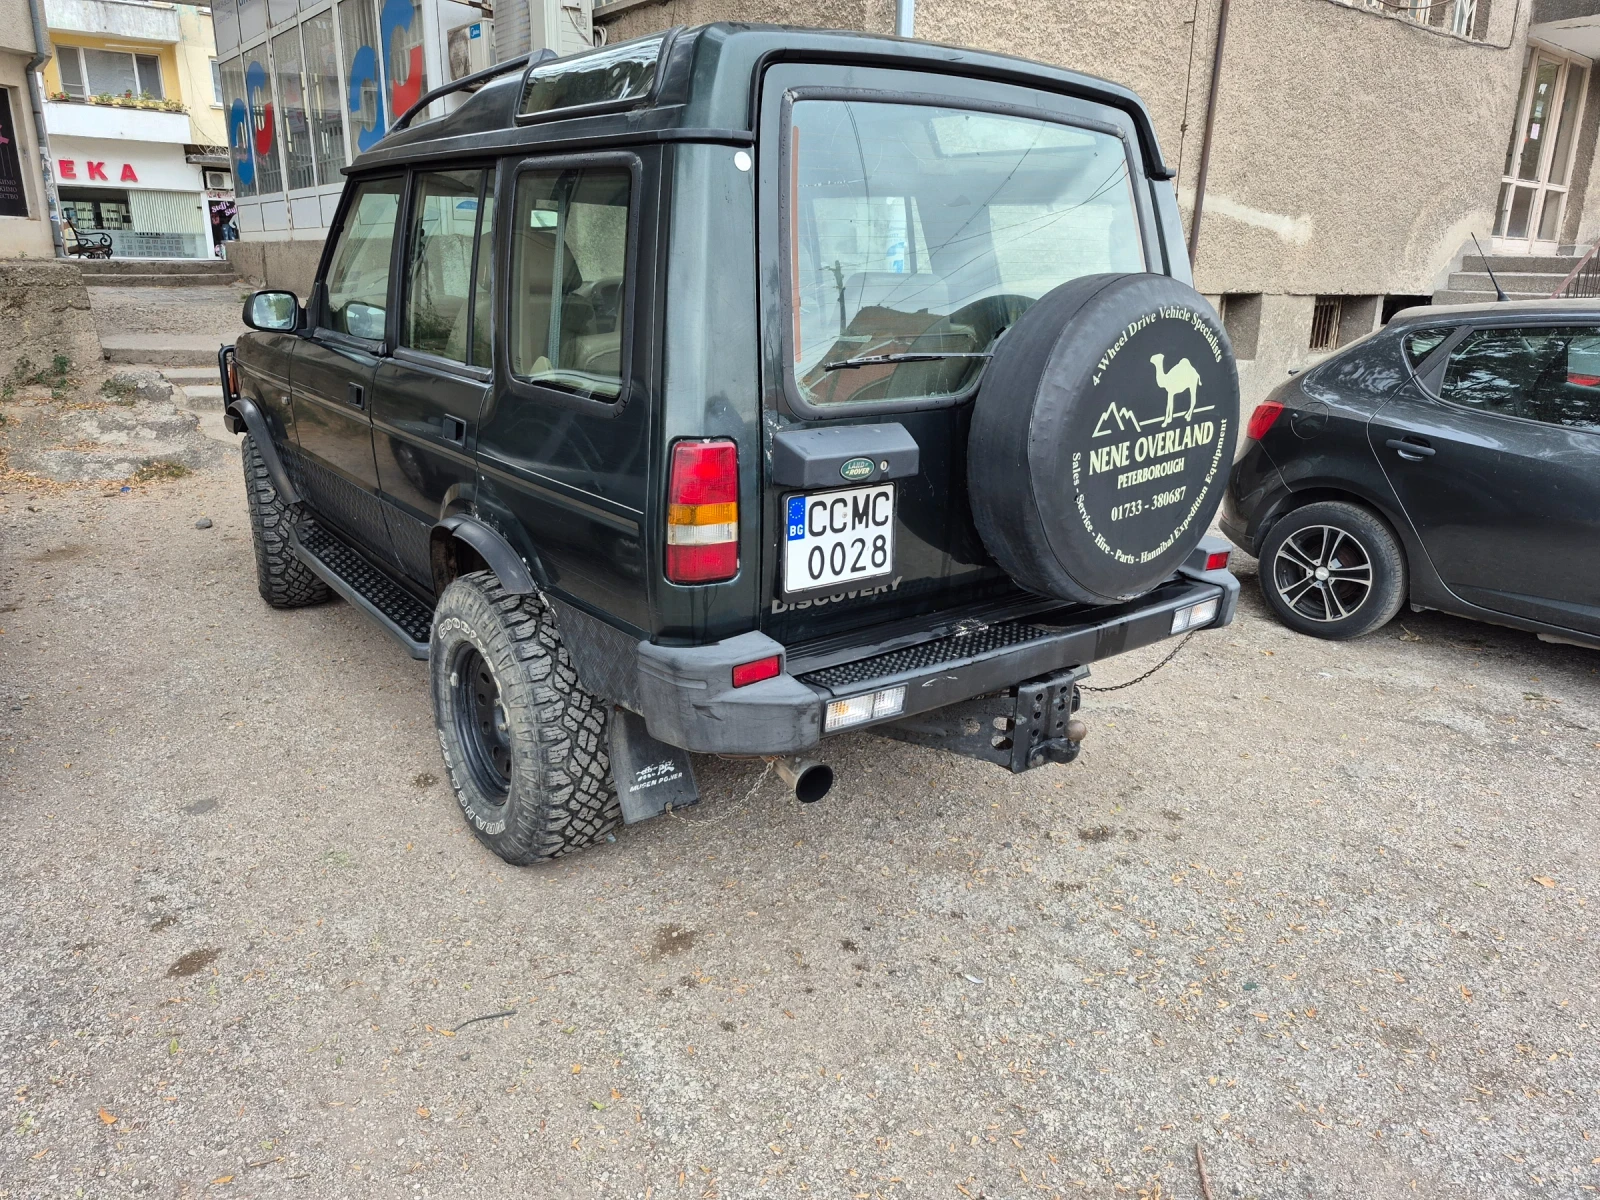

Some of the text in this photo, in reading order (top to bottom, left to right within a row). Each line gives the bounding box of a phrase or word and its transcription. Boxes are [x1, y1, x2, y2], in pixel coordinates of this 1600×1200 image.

[1092, 305, 1223, 386] 4-Wheel Drive Vehicle Specialists
[848, 461, 865, 470] LAND
[1089, 421, 1214, 476] NENE OVERLAND
[1204, 418, 1228, 485] Equipment
[848, 467, 870, 476] ROVER
[1072, 452, 1082, 486] Sales
[1117, 457, 1185, 490] PETERBOROUGH
[808, 491, 890, 537] CCMC
[1076, 493, 1093, 533] Service
[1111, 499, 1143, 522] 01733
[1151, 486, 1187, 511] 380687
[1173, 485, 1208, 540] Expedition
[789, 525, 804, 537] BG
[1094, 533, 1111, 555] Hire
[808, 534, 887, 581] 0028
[1114, 548, 1135, 565] Parts
[1140, 534, 1174, 564] Hannibal
